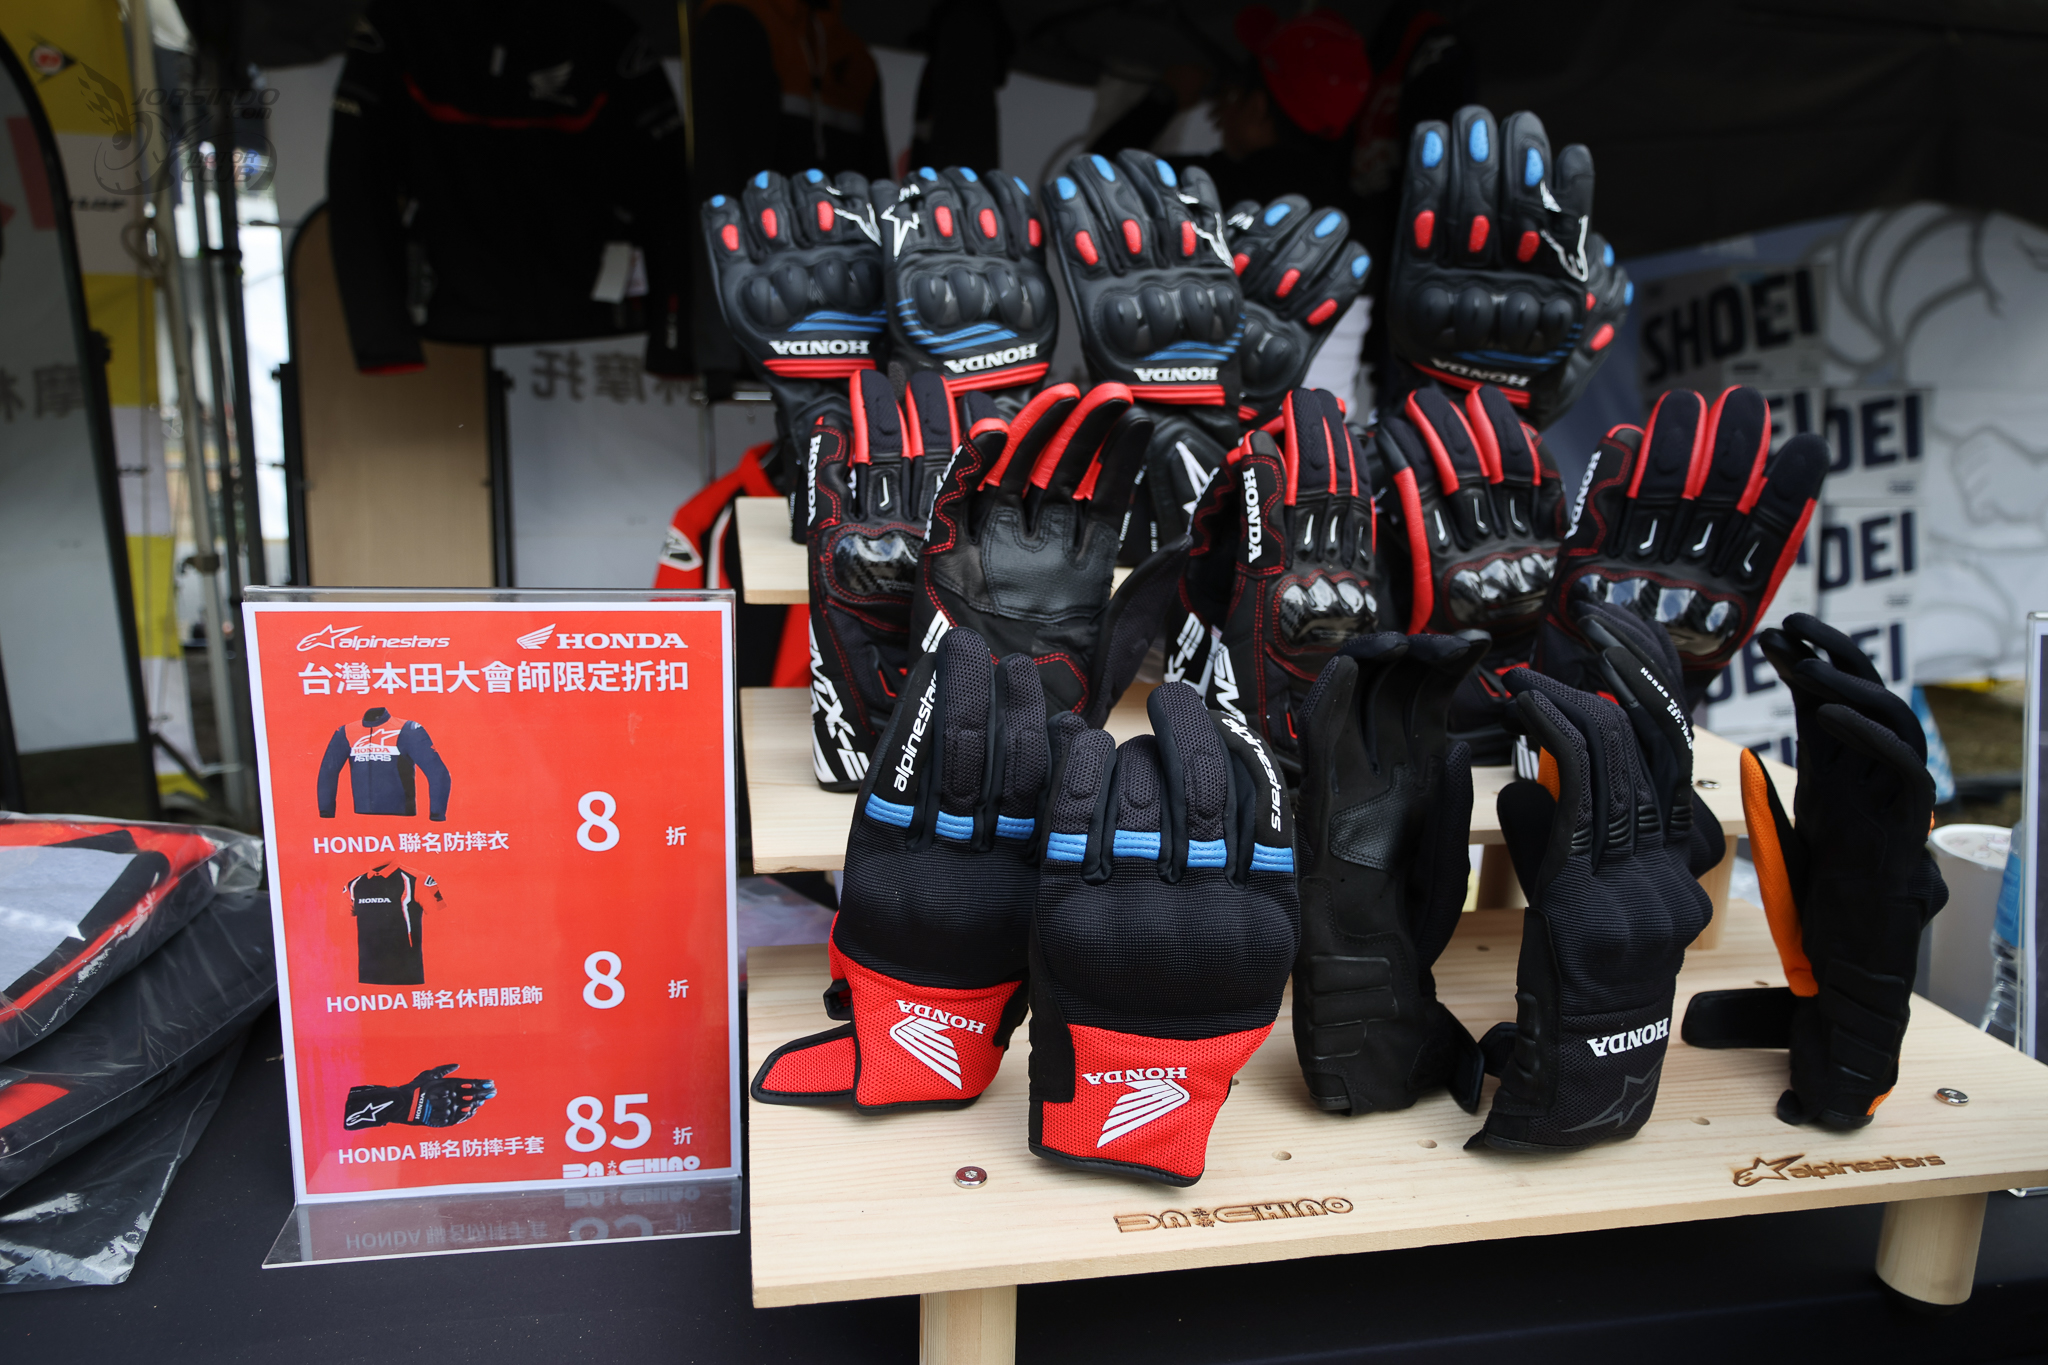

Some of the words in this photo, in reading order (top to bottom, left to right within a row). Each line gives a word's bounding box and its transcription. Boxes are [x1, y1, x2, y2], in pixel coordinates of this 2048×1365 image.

[1643, 269, 1819, 386] SHOEI
[769, 340, 870, 355] HONDA
[943, 343, 1038, 374] HONDA
[1133, 366, 1219, 382] HONDA
[1431, 358, 1530, 387] HONDA
[807, 434, 822, 526] HONDA
[1564, 450, 1602, 539] HONDA
[1242, 467, 1262, 563] HONDA
[339, 635, 451, 651] alpinestars
[557, 633, 689, 649] HONDA
[298, 659, 689, 695] 台灣本田大會師限定折扣
[1640, 667, 1669, 698] Honda
[1221, 718, 1281, 832] alpinestars
[576, 791, 620, 852] 8
[665, 826, 687, 846] 折
[313, 835, 395, 854] HONDA
[398, 831, 510, 853] 聯名防摔衣
[582, 950, 625, 1009] 8
[667, 979, 689, 999] 折
[326, 994, 408, 1013] HONDA
[412, 986, 543, 1011] 聯名休閒服飾
[896, 999, 986, 1034] HONDA
[1587, 1018, 1669, 1057] HONDA
[1082, 1067, 1188, 1085] HONDA
[415, 1092, 426, 1120] HONDA
[564, 1093, 652, 1152] 85
[673, 1126, 693, 1145] 折
[338, 1144, 416, 1164] HONDA
[419, 1136, 545, 1160] 聯名防摔手套
[1789, 1156, 1946, 1179] alpinestars
